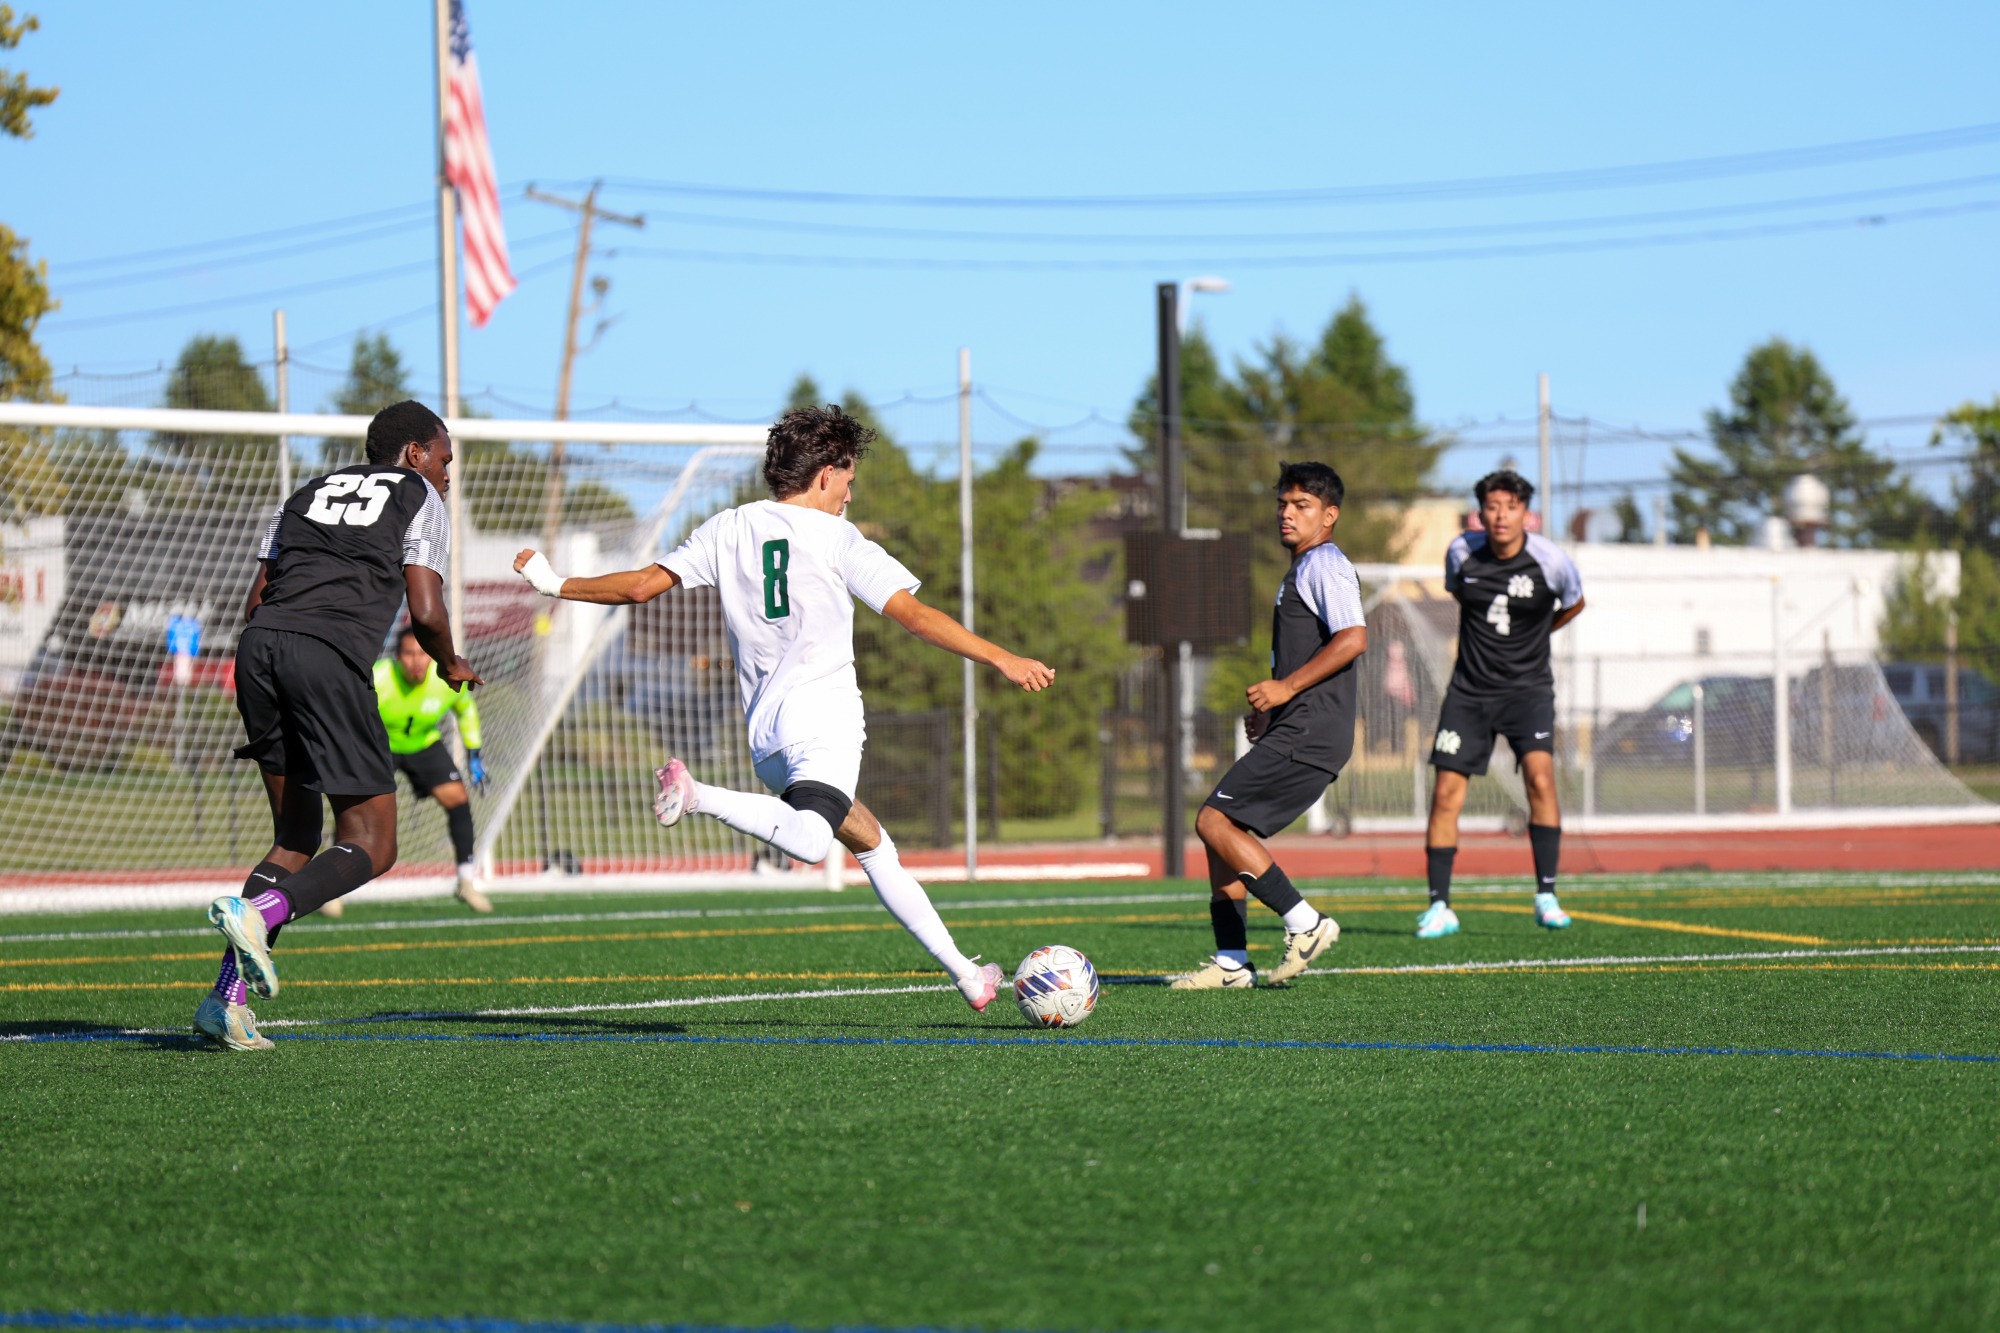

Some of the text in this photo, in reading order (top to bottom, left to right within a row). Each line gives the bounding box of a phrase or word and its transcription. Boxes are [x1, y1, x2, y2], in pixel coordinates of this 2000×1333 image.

[303, 473, 406, 527] 25
[762, 538, 790, 619] 8
[1486, 593, 1511, 636] 4
[404, 716, 414, 736] 1
